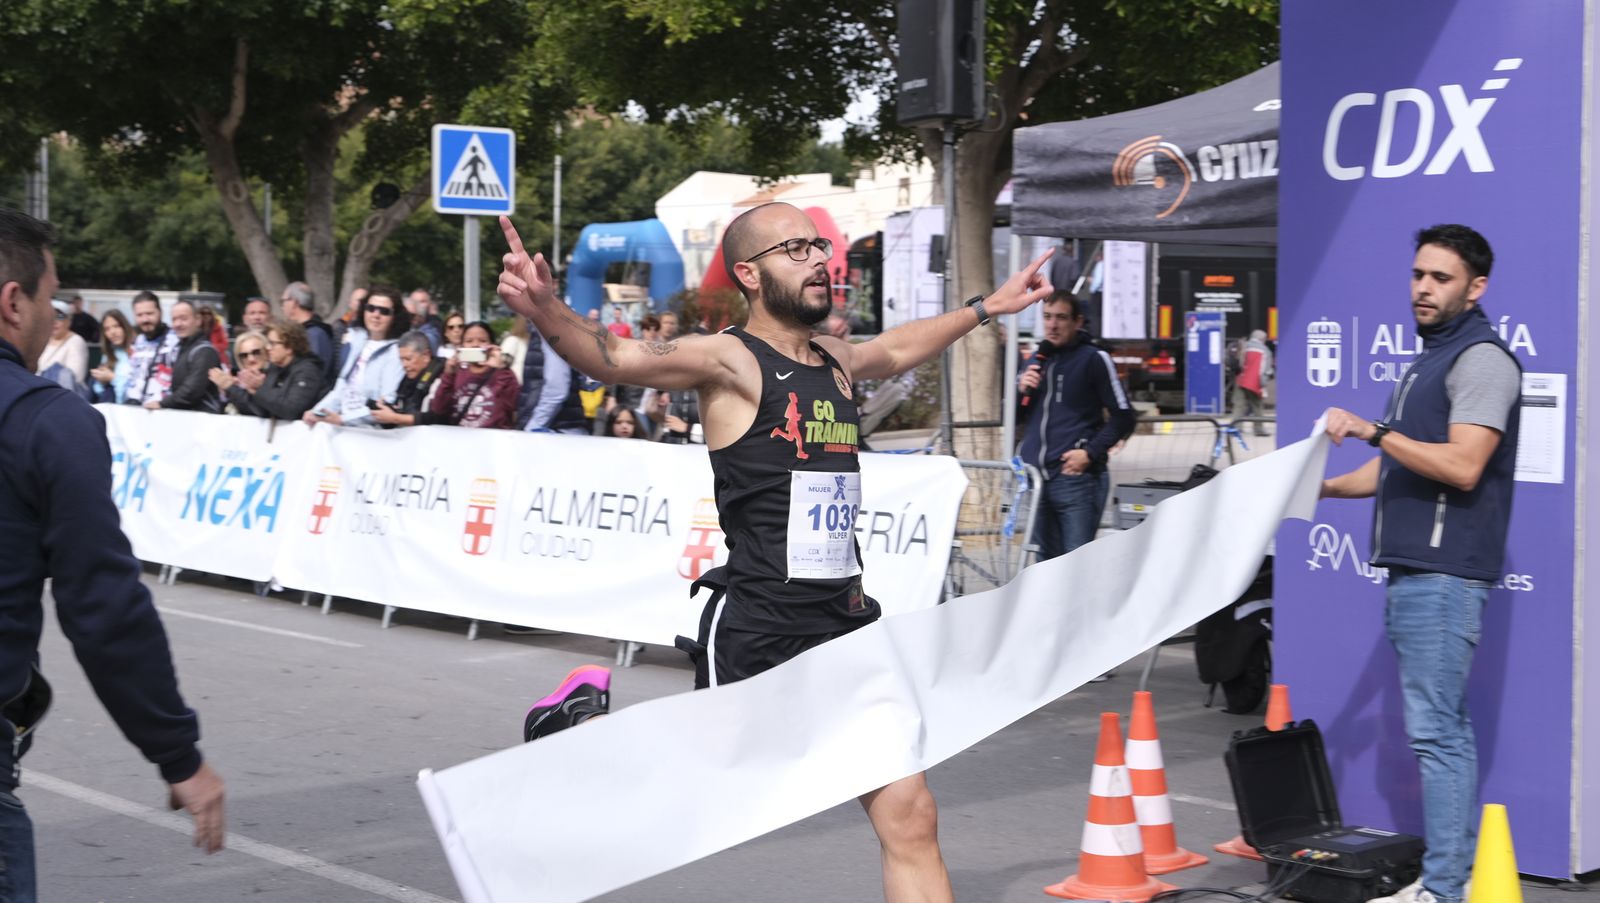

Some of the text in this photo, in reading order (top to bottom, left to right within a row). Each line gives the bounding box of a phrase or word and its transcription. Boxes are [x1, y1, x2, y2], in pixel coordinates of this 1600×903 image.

[1322, 58, 1523, 180] CDX
[354, 467, 450, 512] ALMERÍA
[808, 485, 832, 493] MUJER
[523, 486, 671, 537] ALMERÍA
[520, 531, 593, 562] CIUDAD
[828, 531, 848, 539] VILPER
